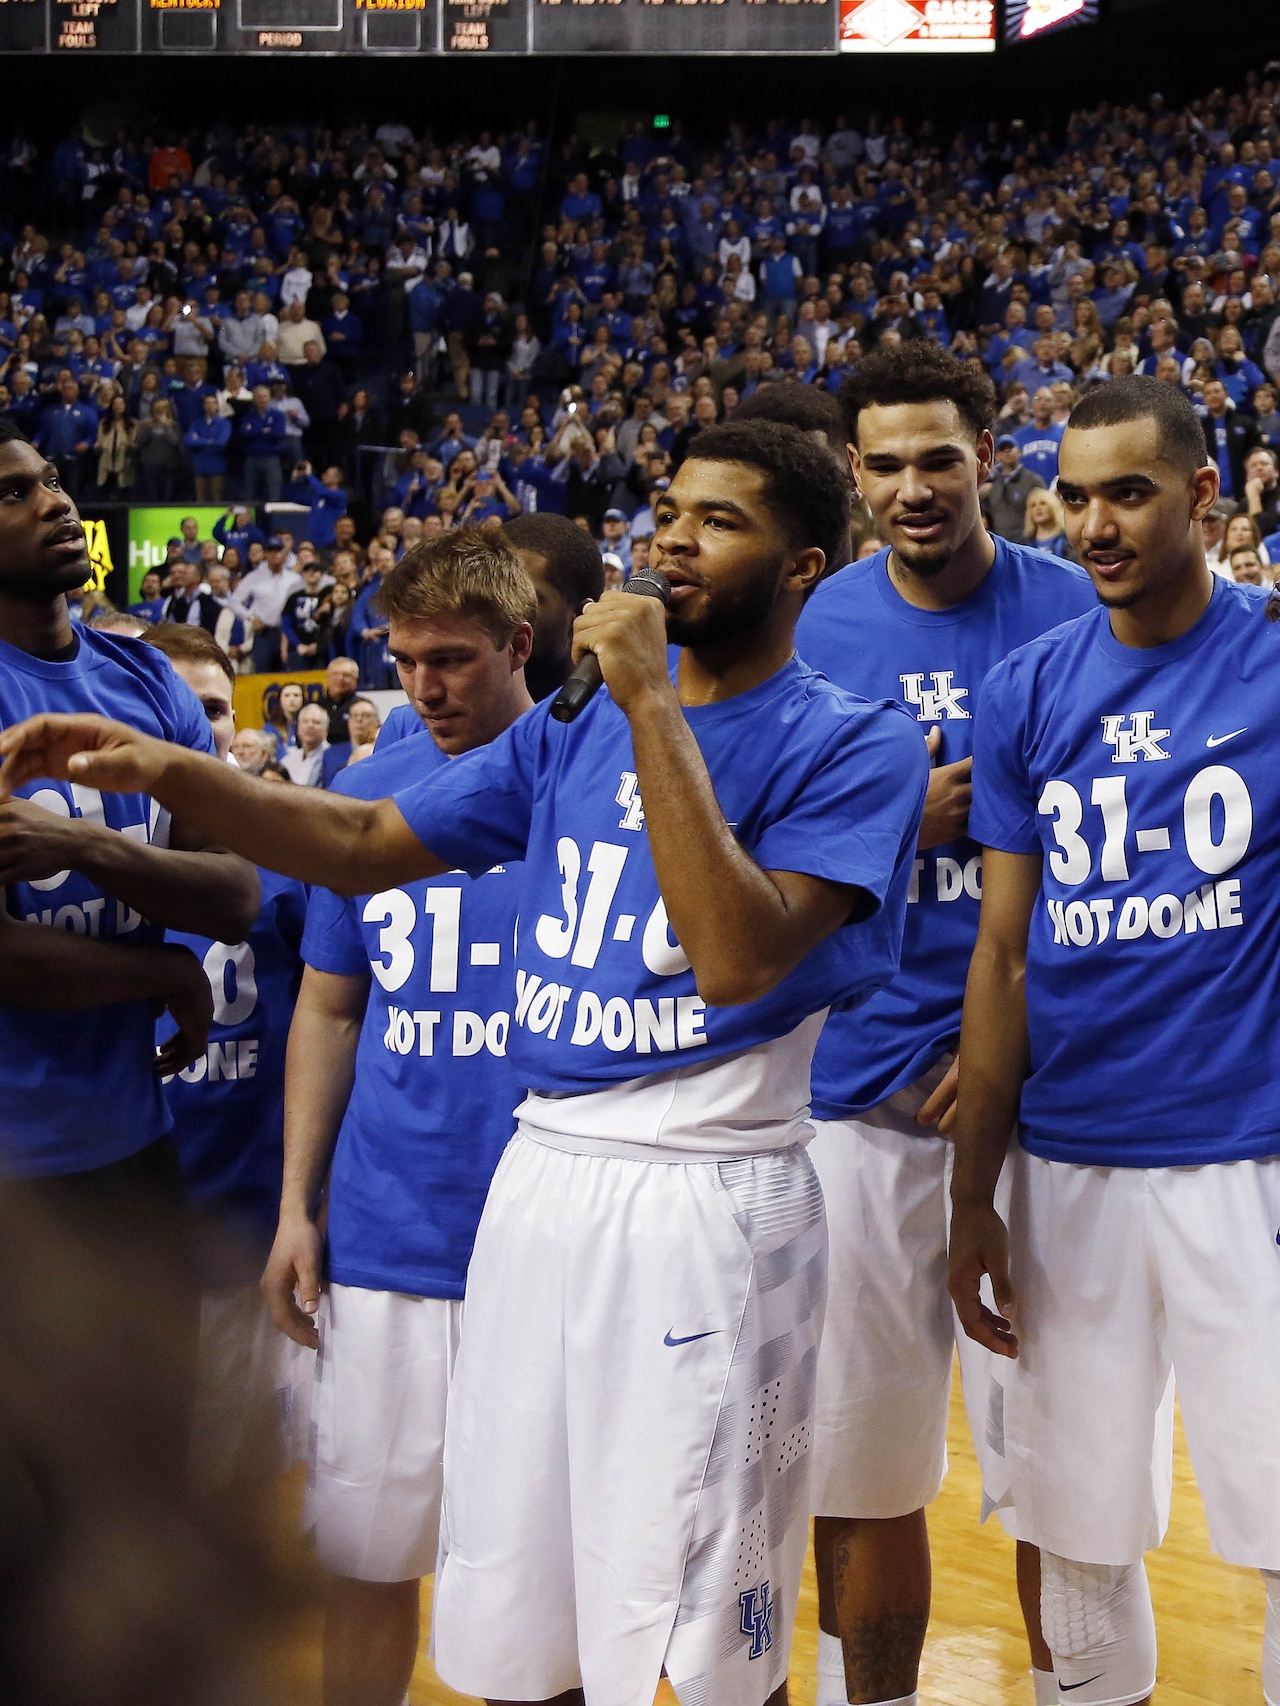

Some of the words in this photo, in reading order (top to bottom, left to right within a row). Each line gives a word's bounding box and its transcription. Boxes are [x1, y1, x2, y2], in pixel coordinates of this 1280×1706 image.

[58, 34, 97, 48] FOULS
[62, 21, 95, 34] TEAM
[258, 32, 302, 47] PERIOD
[451, 35, 490, 49] FOULS
[454, 22, 487, 35] TEAM
[899, 671, 972, 722] UK
[1100, 710, 1172, 763] UK
[1038, 765, 1252, 886] 31-0
[1047, 899, 1114, 946] NOT
[1116, 879, 1243, 940] DONE
[363, 887, 500, 993] 31-
[570, 990, 708, 1053] DONE
